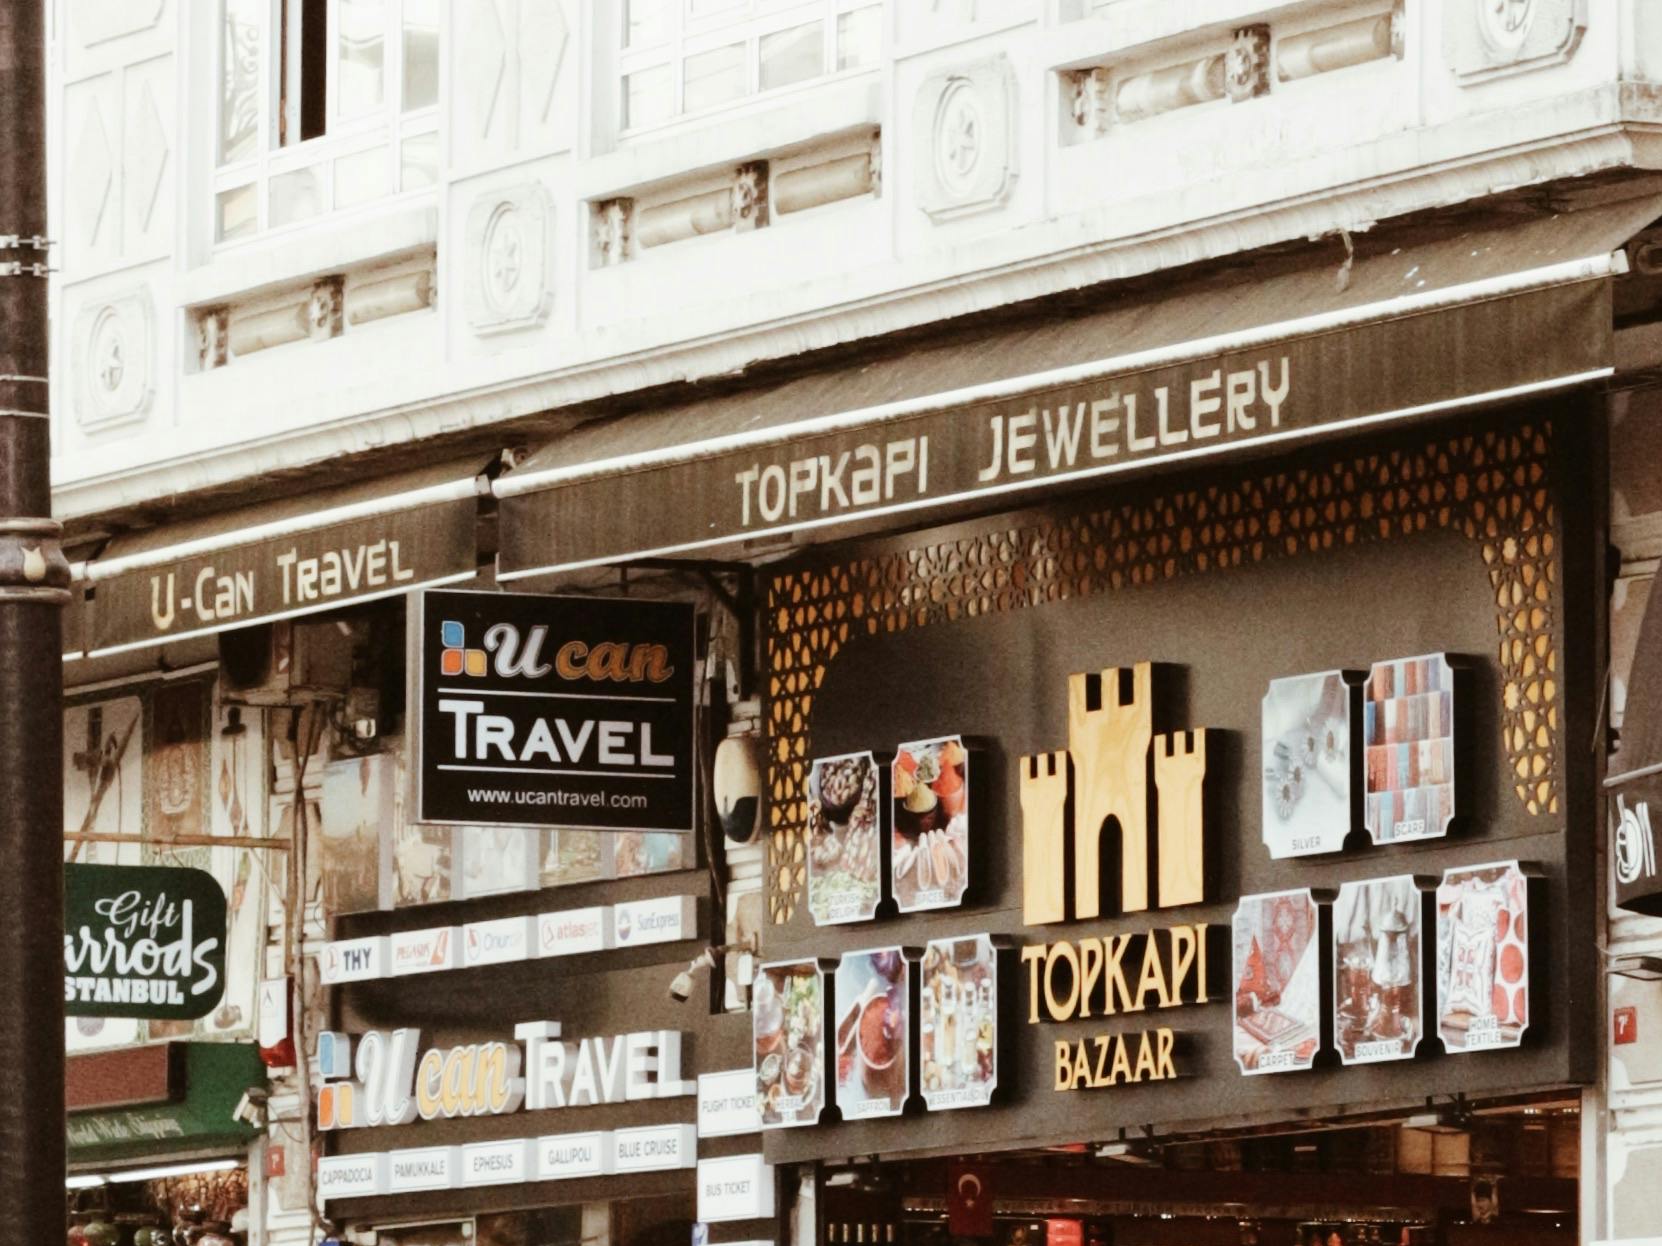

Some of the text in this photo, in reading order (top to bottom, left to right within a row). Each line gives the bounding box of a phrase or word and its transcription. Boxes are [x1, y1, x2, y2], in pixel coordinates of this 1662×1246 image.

[978, 357, 1290, 482] JEWELLERY
[438, 699, 675, 766] TRAVEL
[467, 788, 647, 809] www.ucantravel.com
[1291, 836, 1322, 850] SILVER
[95, 891, 179, 938] Gift
[65, 899, 219, 996] rrods
[343, 947, 372, 971] THY
[1021, 923, 1208, 1023] TOPKAPI
[65, 976, 185, 1005] STANBUL
[514, 1021, 698, 1110] TRAVEL
[1054, 1028, 1177, 1091] BAZAAR
[548, 1147, 592, 1166] GALLIPOLI
[618, 1137, 678, 1158] BLUE CRUISE
[394, 1160, 446, 1179] PAMUKKALE
[473, 1153, 514, 1172] EPHESUS
[321, 1167, 373, 1185] CAPPADOCIA
[705, 1180, 751, 1197] BUS TICKET
